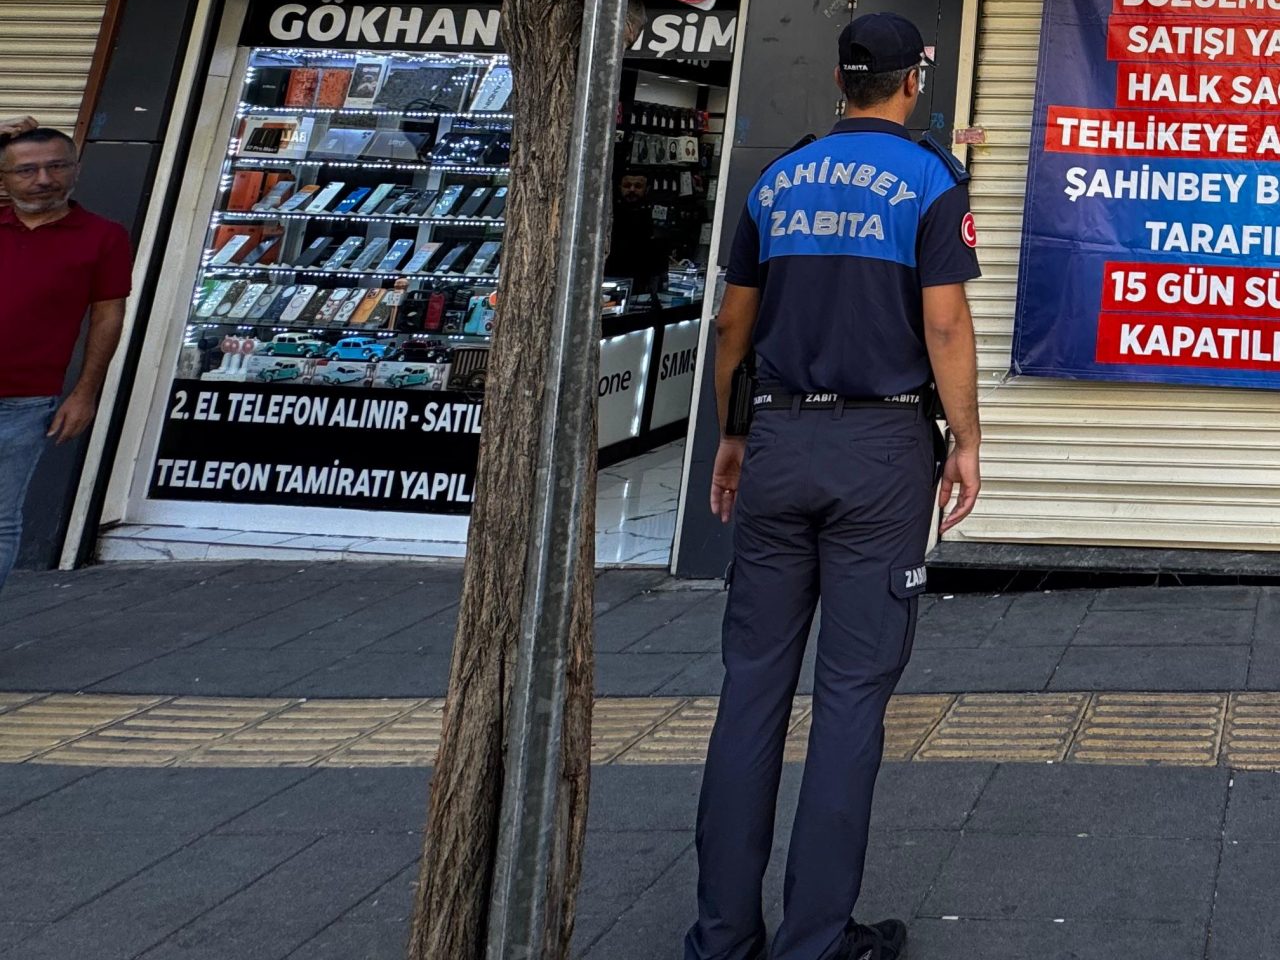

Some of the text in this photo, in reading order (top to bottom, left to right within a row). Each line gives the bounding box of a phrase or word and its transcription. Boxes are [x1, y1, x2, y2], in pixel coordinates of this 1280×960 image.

[1127, 25, 1235, 61] SATIŞI
[1128, 72, 1222, 103] HALK
[1056, 114, 1248, 154] TEHLİKEYE
[758, 156, 916, 208] ŞAHİNBEY
[1063, 164, 1248, 205] ŞAHİNBEY
[770, 210, 885, 240] ZABITA
[1110, 270, 1146, 302] 15
[1157, 267, 1234, 307] GÜN
[169, 390, 189, 420] 2.
[194, 392, 222, 422] EL
[227, 393, 328, 427] TELEFON
[328, 397, 408, 431] ALINIR
[753, 394, 772, 405] ABITA
[805, 393, 838, 402] ZABIT
[157, 458, 476, 503] TELEFON TAMİRATI YAPIL
